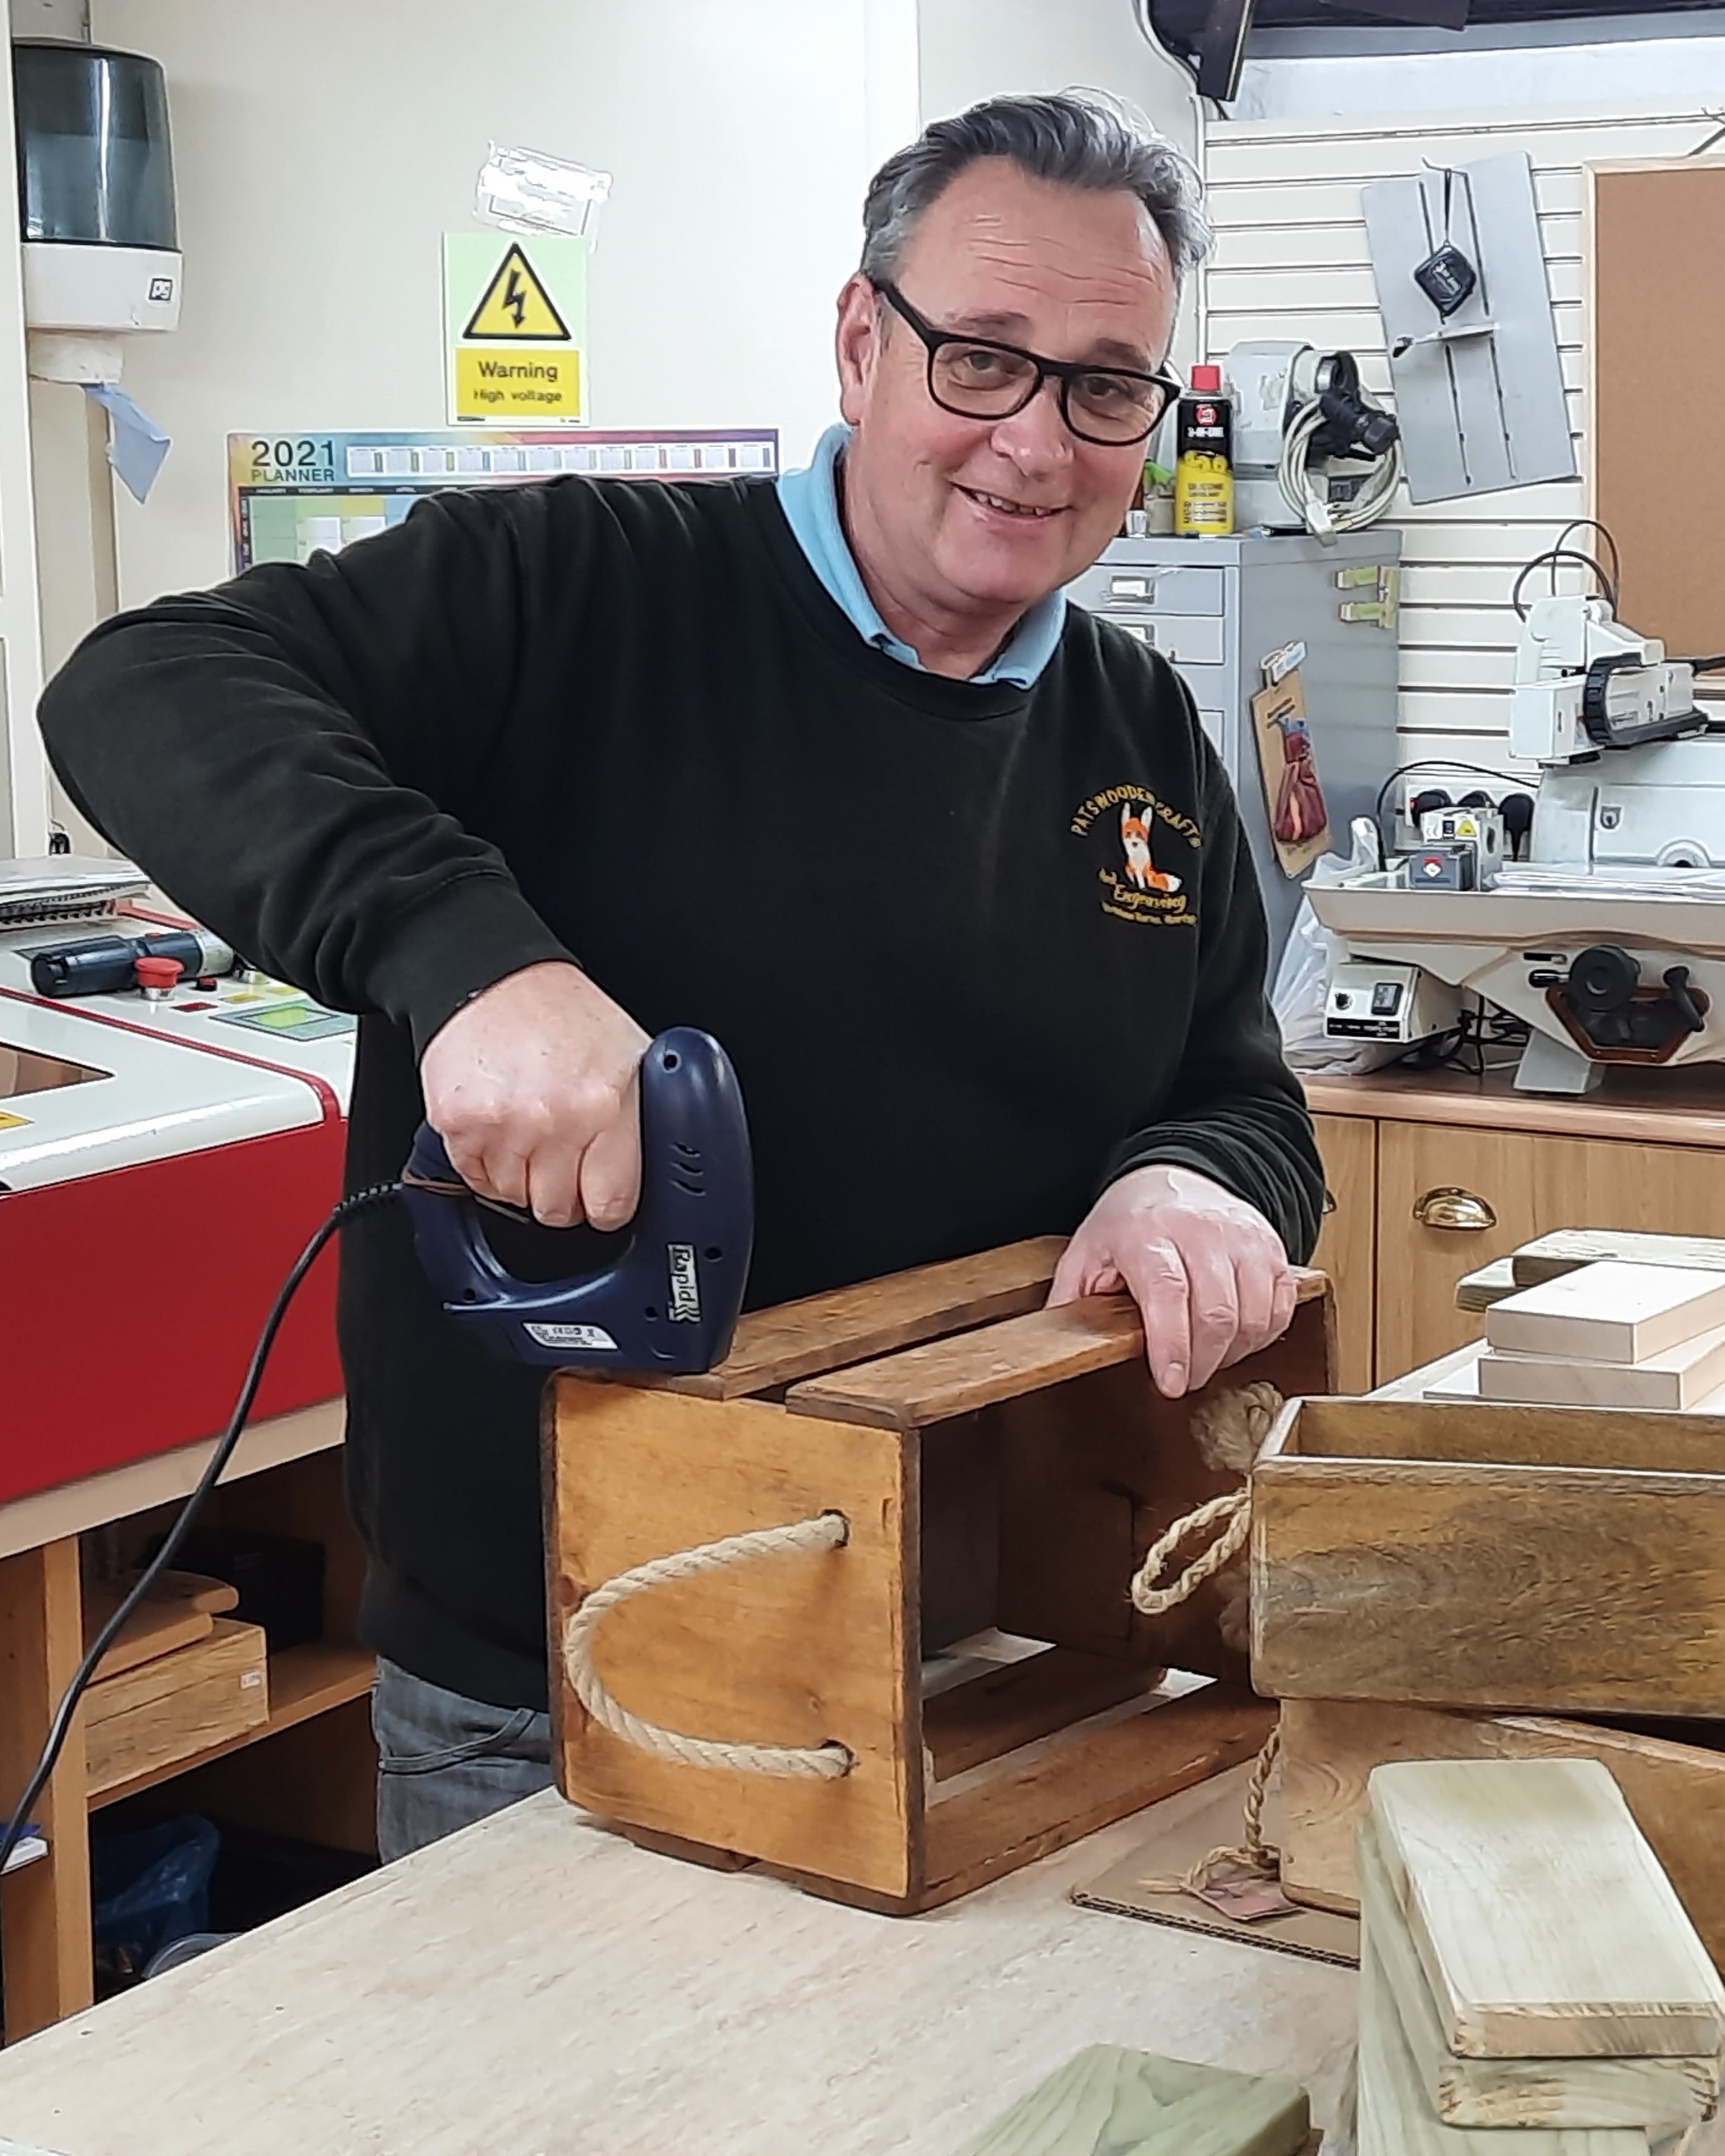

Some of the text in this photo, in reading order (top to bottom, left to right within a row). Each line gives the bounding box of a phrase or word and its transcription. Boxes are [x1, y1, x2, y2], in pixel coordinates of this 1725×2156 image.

[478, 361, 558, 382] Warning
[473, 387, 563, 405] High voltage
[251, 440, 336, 467] 2021
[252, 468, 336, 482] PLANNER
[671, 1247, 696, 1302] Rapid
